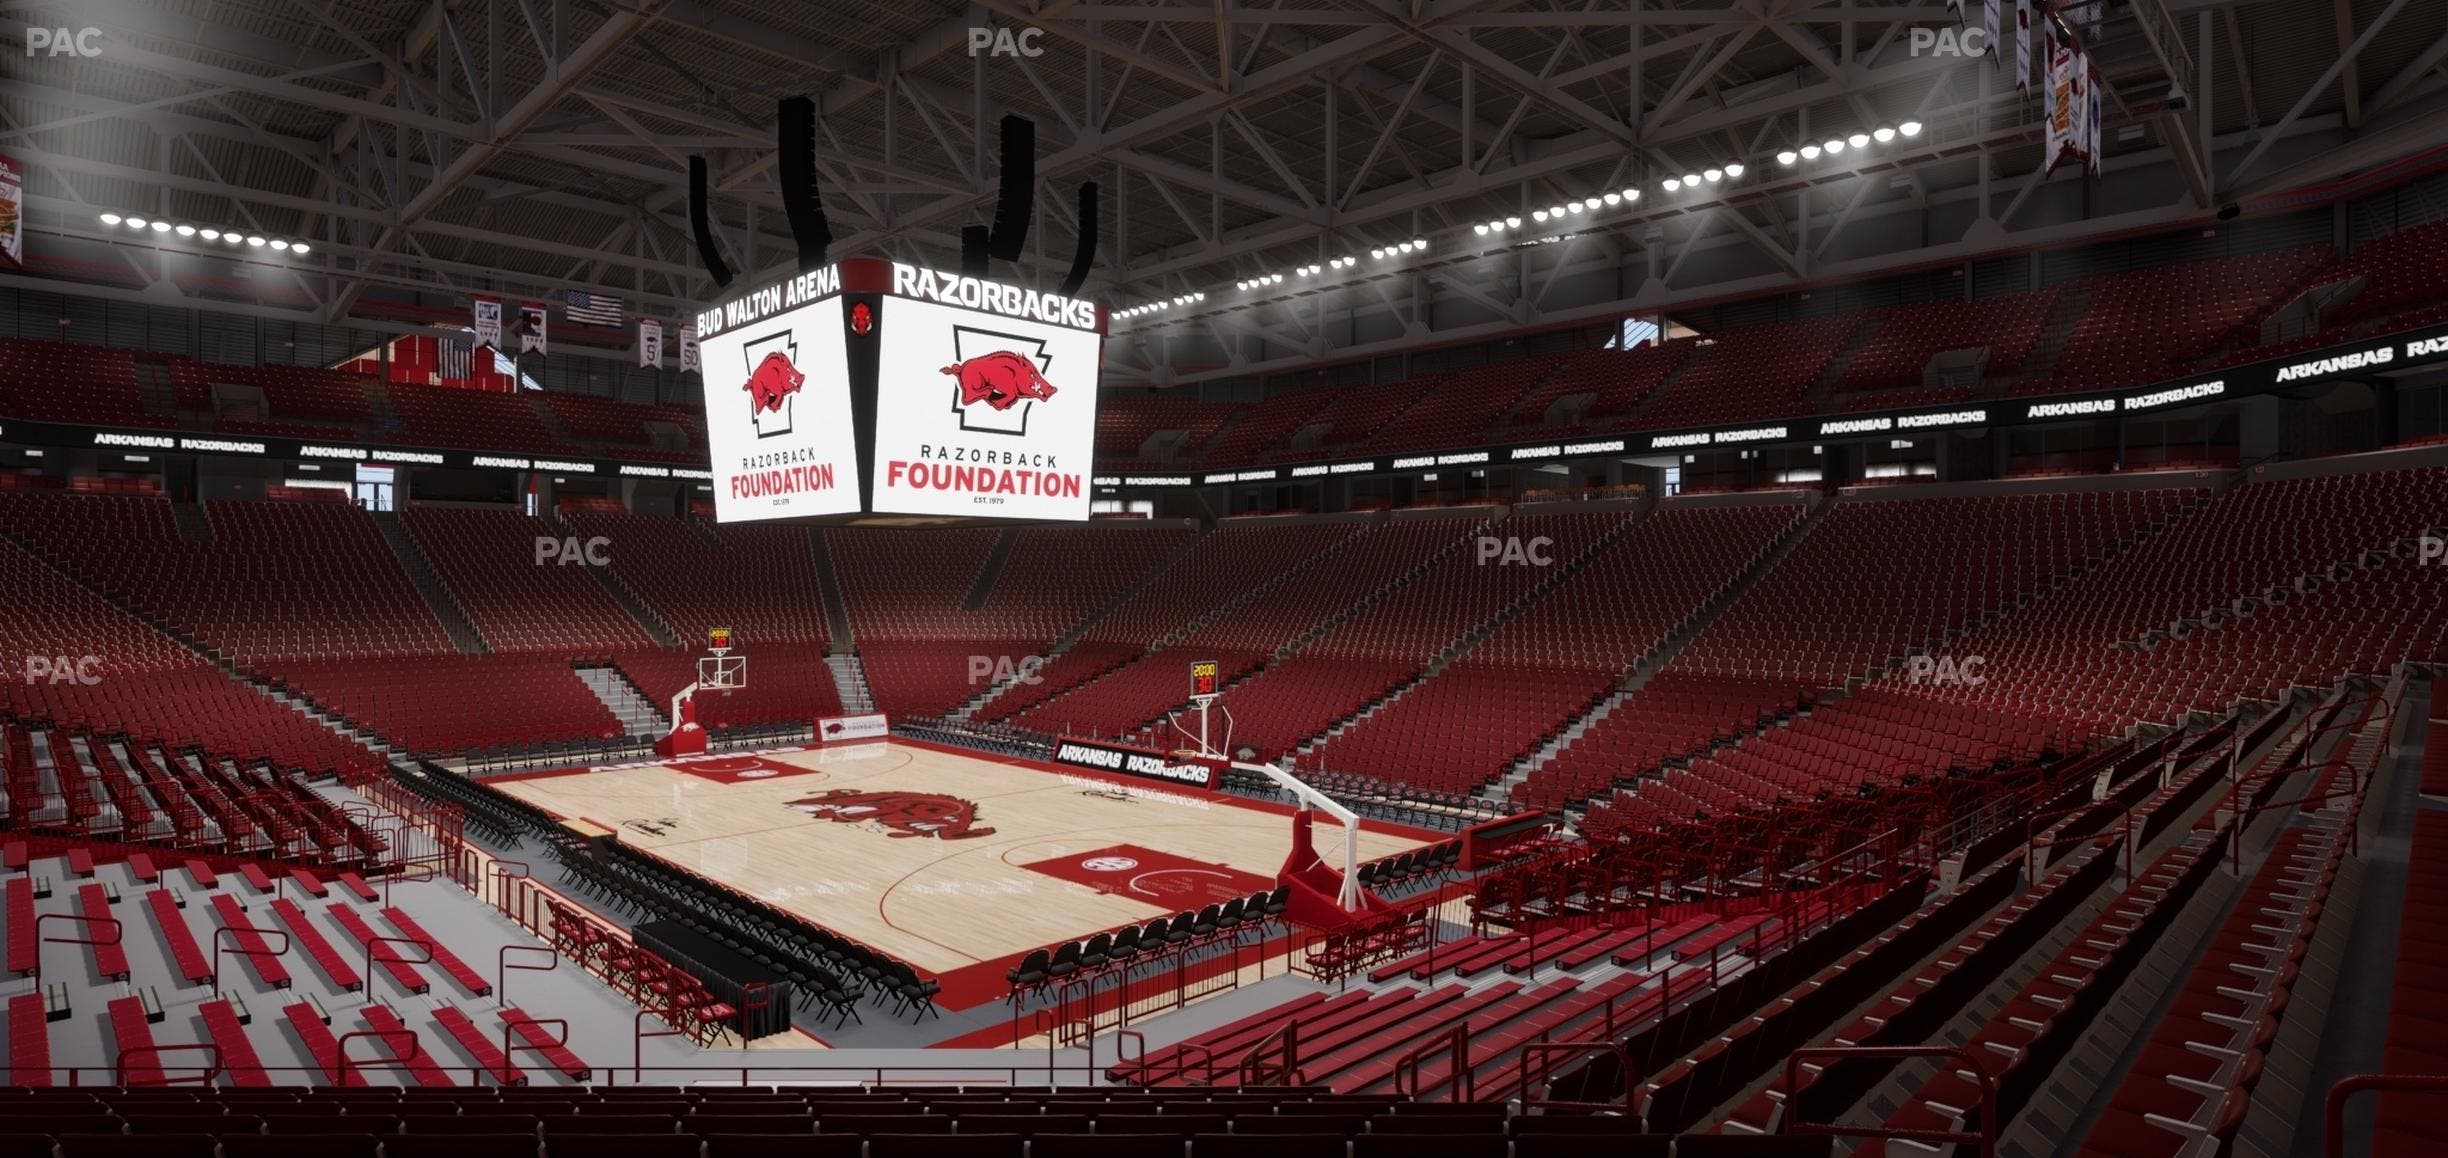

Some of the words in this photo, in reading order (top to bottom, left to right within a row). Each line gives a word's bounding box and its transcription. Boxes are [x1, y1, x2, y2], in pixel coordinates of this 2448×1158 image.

[697, 307, 723, 338] BUD
[726, 284, 781, 328] WALTON
[785, 263, 841, 308] ARENA
[891, 261, 1096, 330] RAZORBACKS
[2276, 346, 2394, 383] ARKANSAS
[2027, 398, 2116, 418] ARKANSAS
[2124, 380, 2225, 410] RAZORBACKS
[1820, 417, 1892, 434] ARKANSAS
[1897, 410, 1987, 428] RAZORBACKS
[93, 433, 175, 449] ARKANSAS
[180, 438, 266, 454] RAZORBACKS
[1651, 432, 1711, 448] ARKANSAS
[1714, 427, 1788, 443] RAZORBACKS
[300, 446, 368, 460] ARKANSAS
[372, 450, 444, 464] RAZORBACKS
[742, 447, 816, 471] RAZORBACK
[920, 444, 1057, 469] RAZORBACK
[1392, 456, 1436, 469] ARKANSAS
[1437, 452, 1489, 465] RAZORBACKS
[1511, 446, 1561, 460] ARKANSAS
[1563, 440, 1625, 455] RAZORBACKS
[472, 456, 531, 469] ARKANSAS
[533, 460, 596, 473] RAZORBACKS
[619, 465, 670, 477] ARKANSAS
[731, 463, 834, 500] FOUNDATION
[888, 460, 1081, 499] FOUNDATION
[1193, 664, 1215, 677] 20:00
[1198, 677, 1212, 693] 30
[1057, 744, 1123, 769] ARKANSAS
